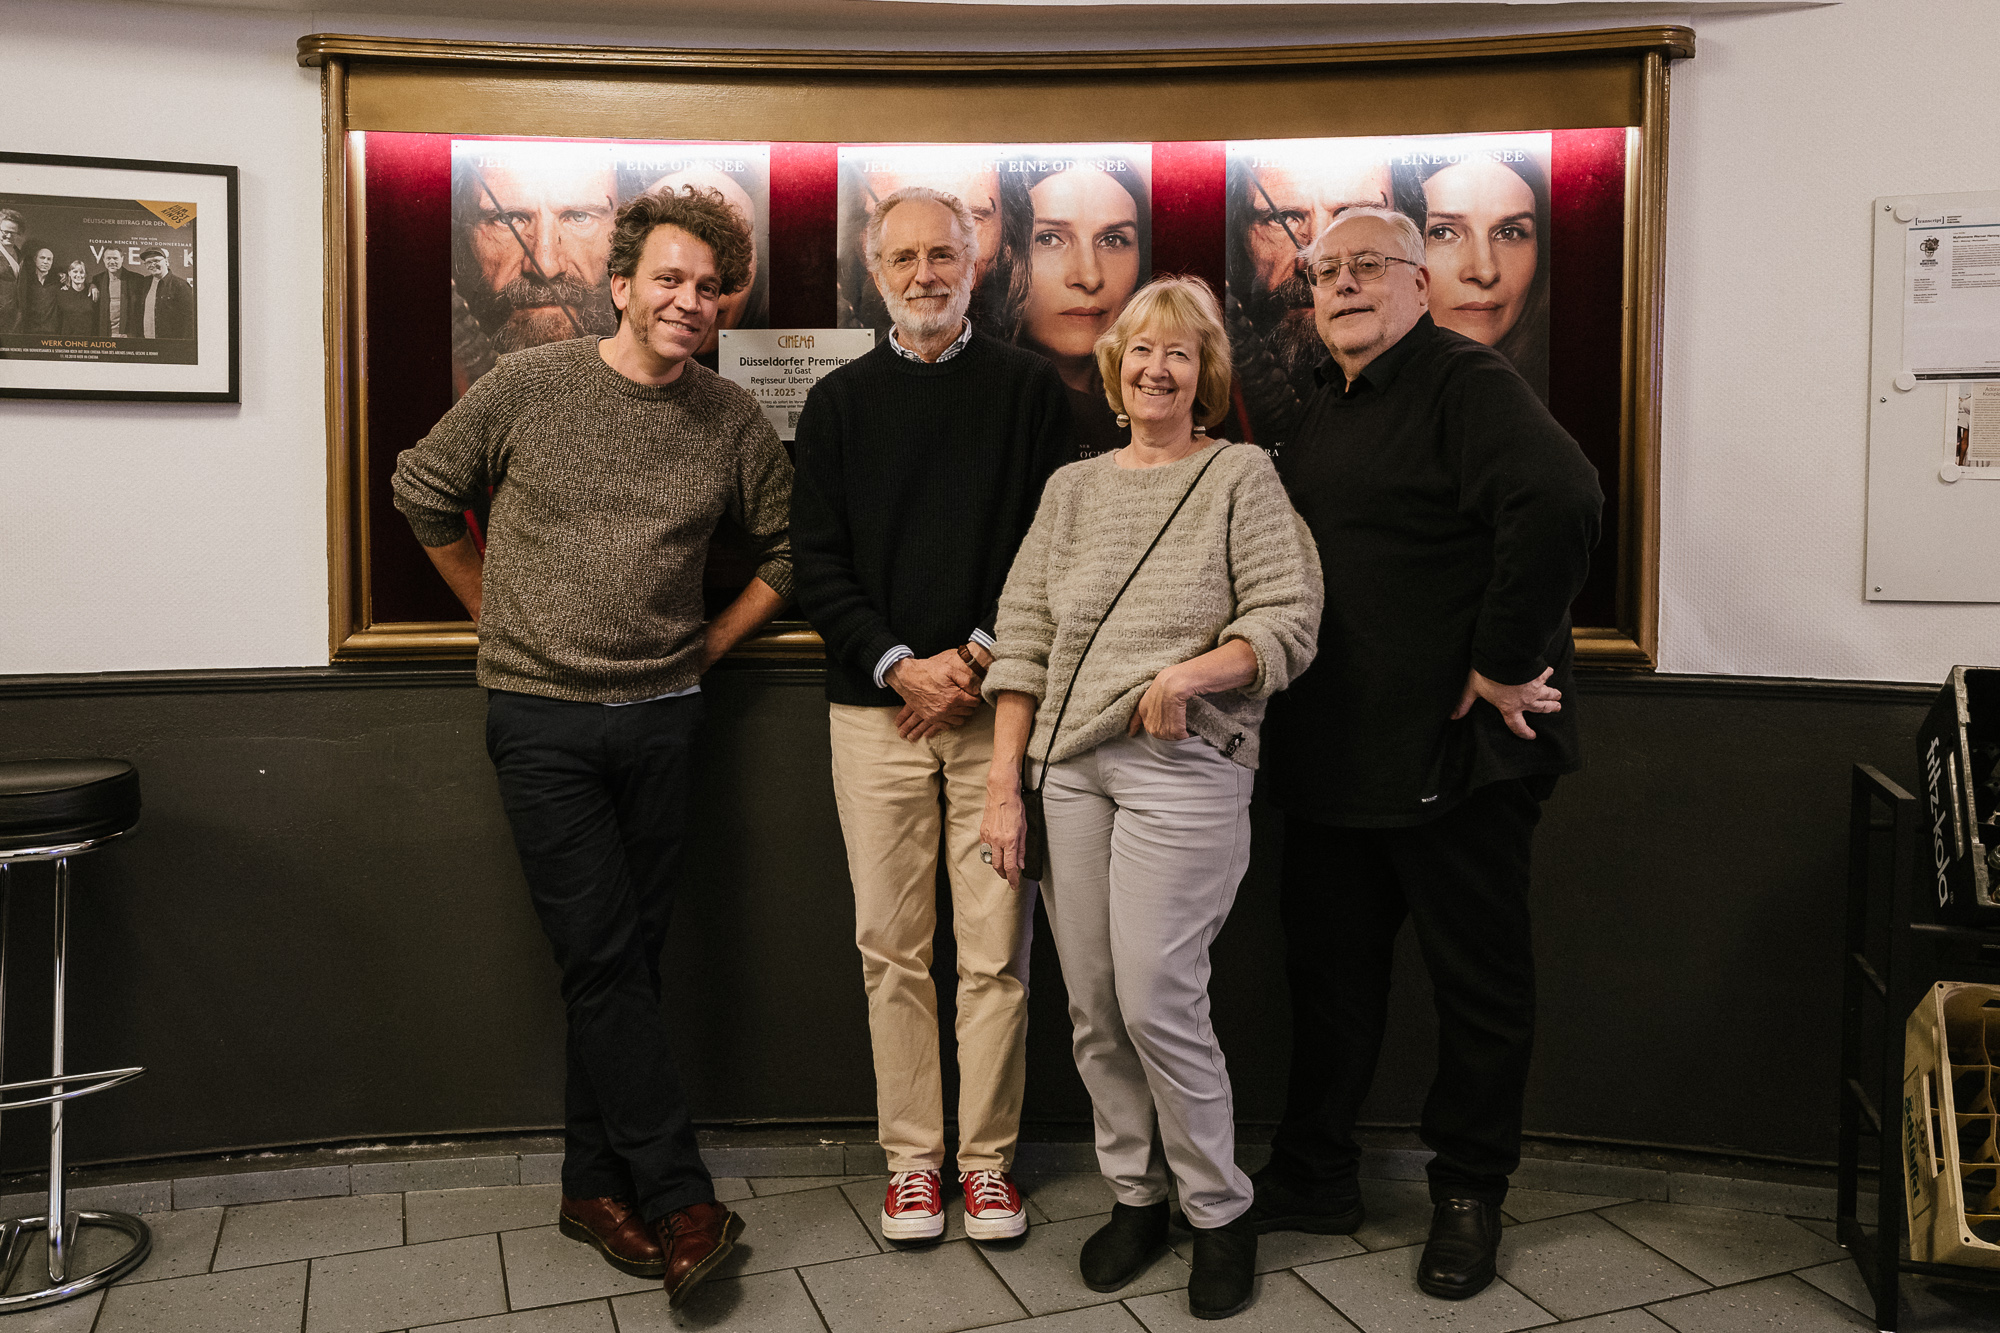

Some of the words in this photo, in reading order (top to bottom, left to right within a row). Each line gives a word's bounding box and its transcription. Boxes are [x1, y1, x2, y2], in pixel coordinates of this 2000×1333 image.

[626, 159, 667, 172] EINE
[670, 159, 746, 173] ODYSSEE
[1400, 153, 1442, 166] EINE
[977, 160, 1004, 173] IST
[1008, 160, 1049, 173] EINE
[160, 209, 184, 224] KINOS
[167, 206, 190, 220] KUNST
[83, 217, 115, 225] DEUTSCHER
[117, 218, 140, 227] BEITRAG
[142, 217, 152, 227] FÜR
[153, 219, 166, 227] DEN
[64, 340, 89, 348] OHNE
[90, 341, 117, 349] AUTOR
[777, 334, 815, 349] CINEMA
[739, 356, 805, 367] Düsseldorfer
[794, 367, 812, 375] Gast
[750, 376, 786, 386] Regisseur
[788, 376, 814, 385] Uberto
[1926, 736, 1950, 908] fritz-kola
